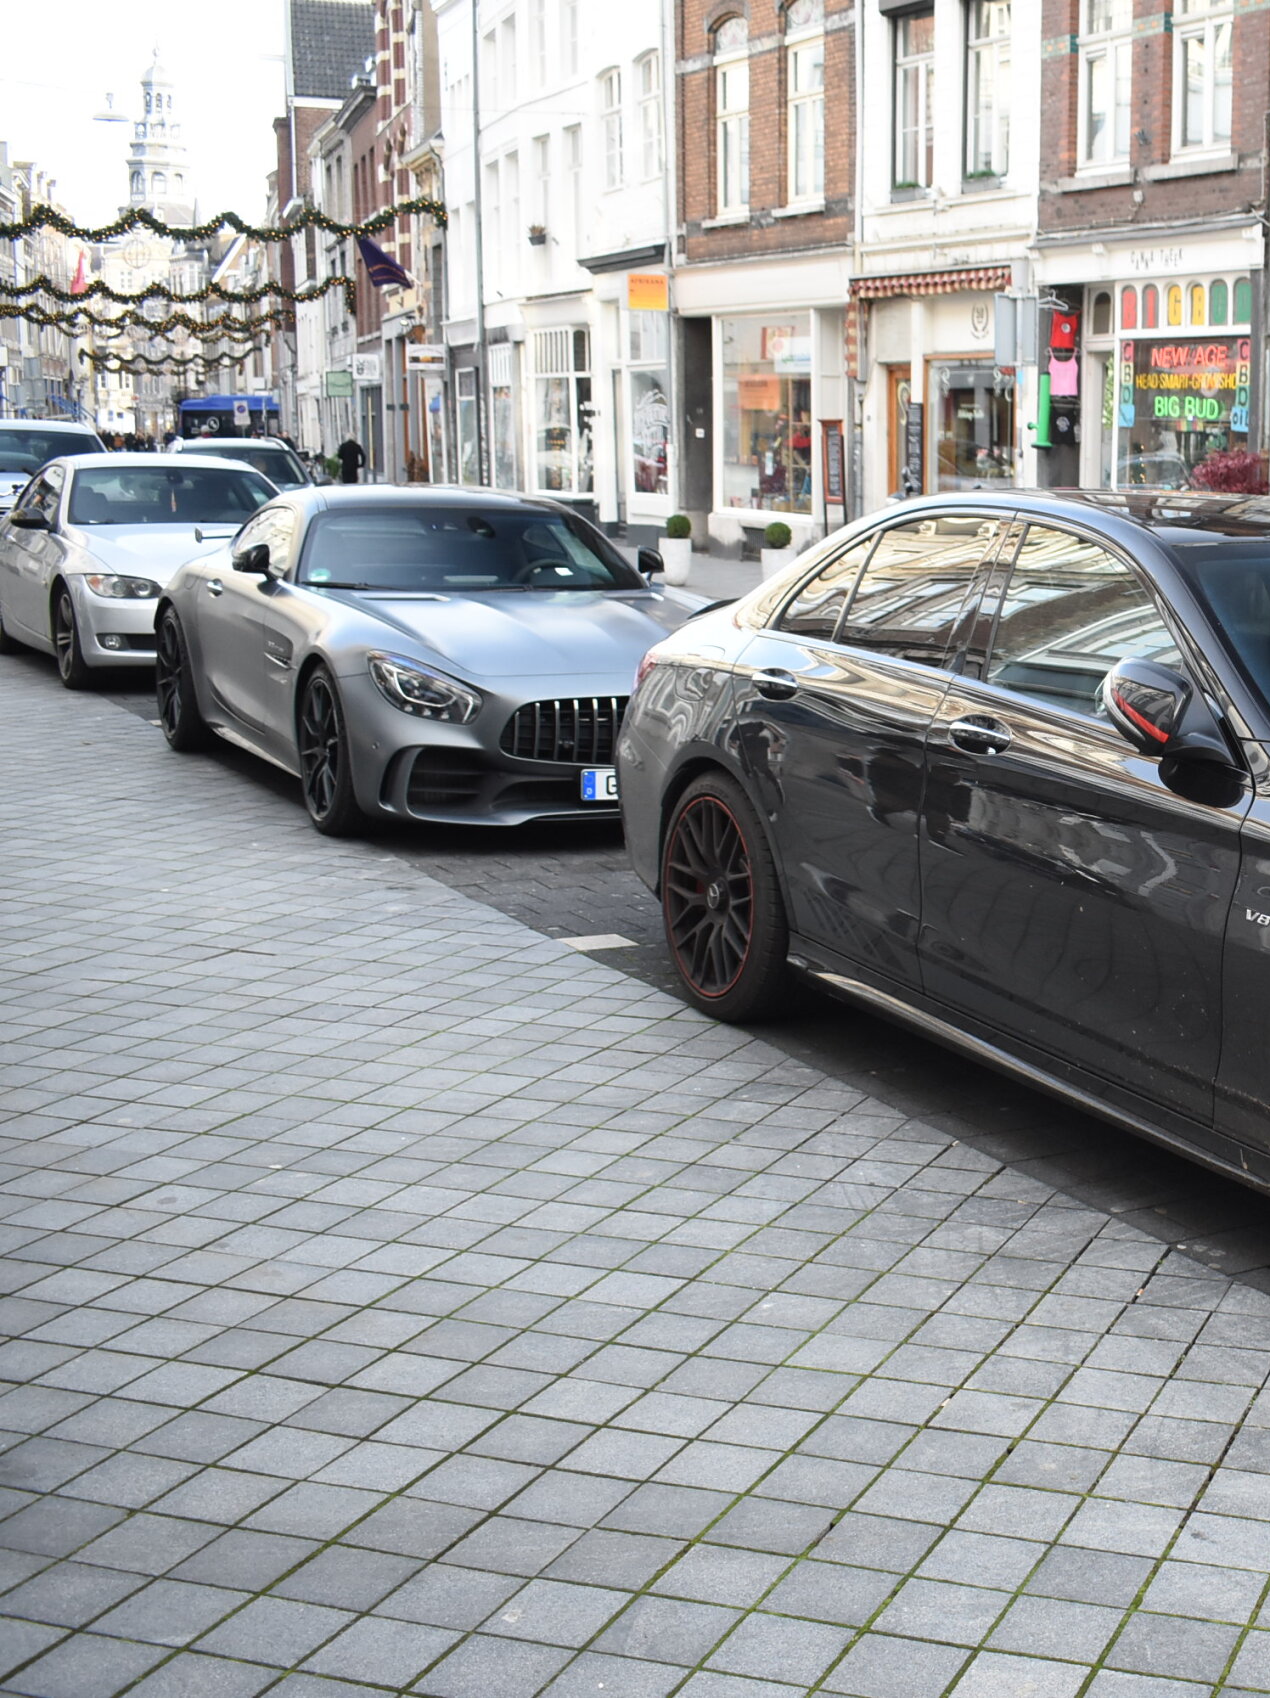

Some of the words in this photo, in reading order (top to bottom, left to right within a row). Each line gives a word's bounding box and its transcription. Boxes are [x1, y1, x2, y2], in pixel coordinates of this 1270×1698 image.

[1151, 346, 1189, 368] NEW
[1193, 345, 1229, 367] AGE
[1154, 395, 1180, 418] BIG
[1184, 396, 1220, 420] BUD
